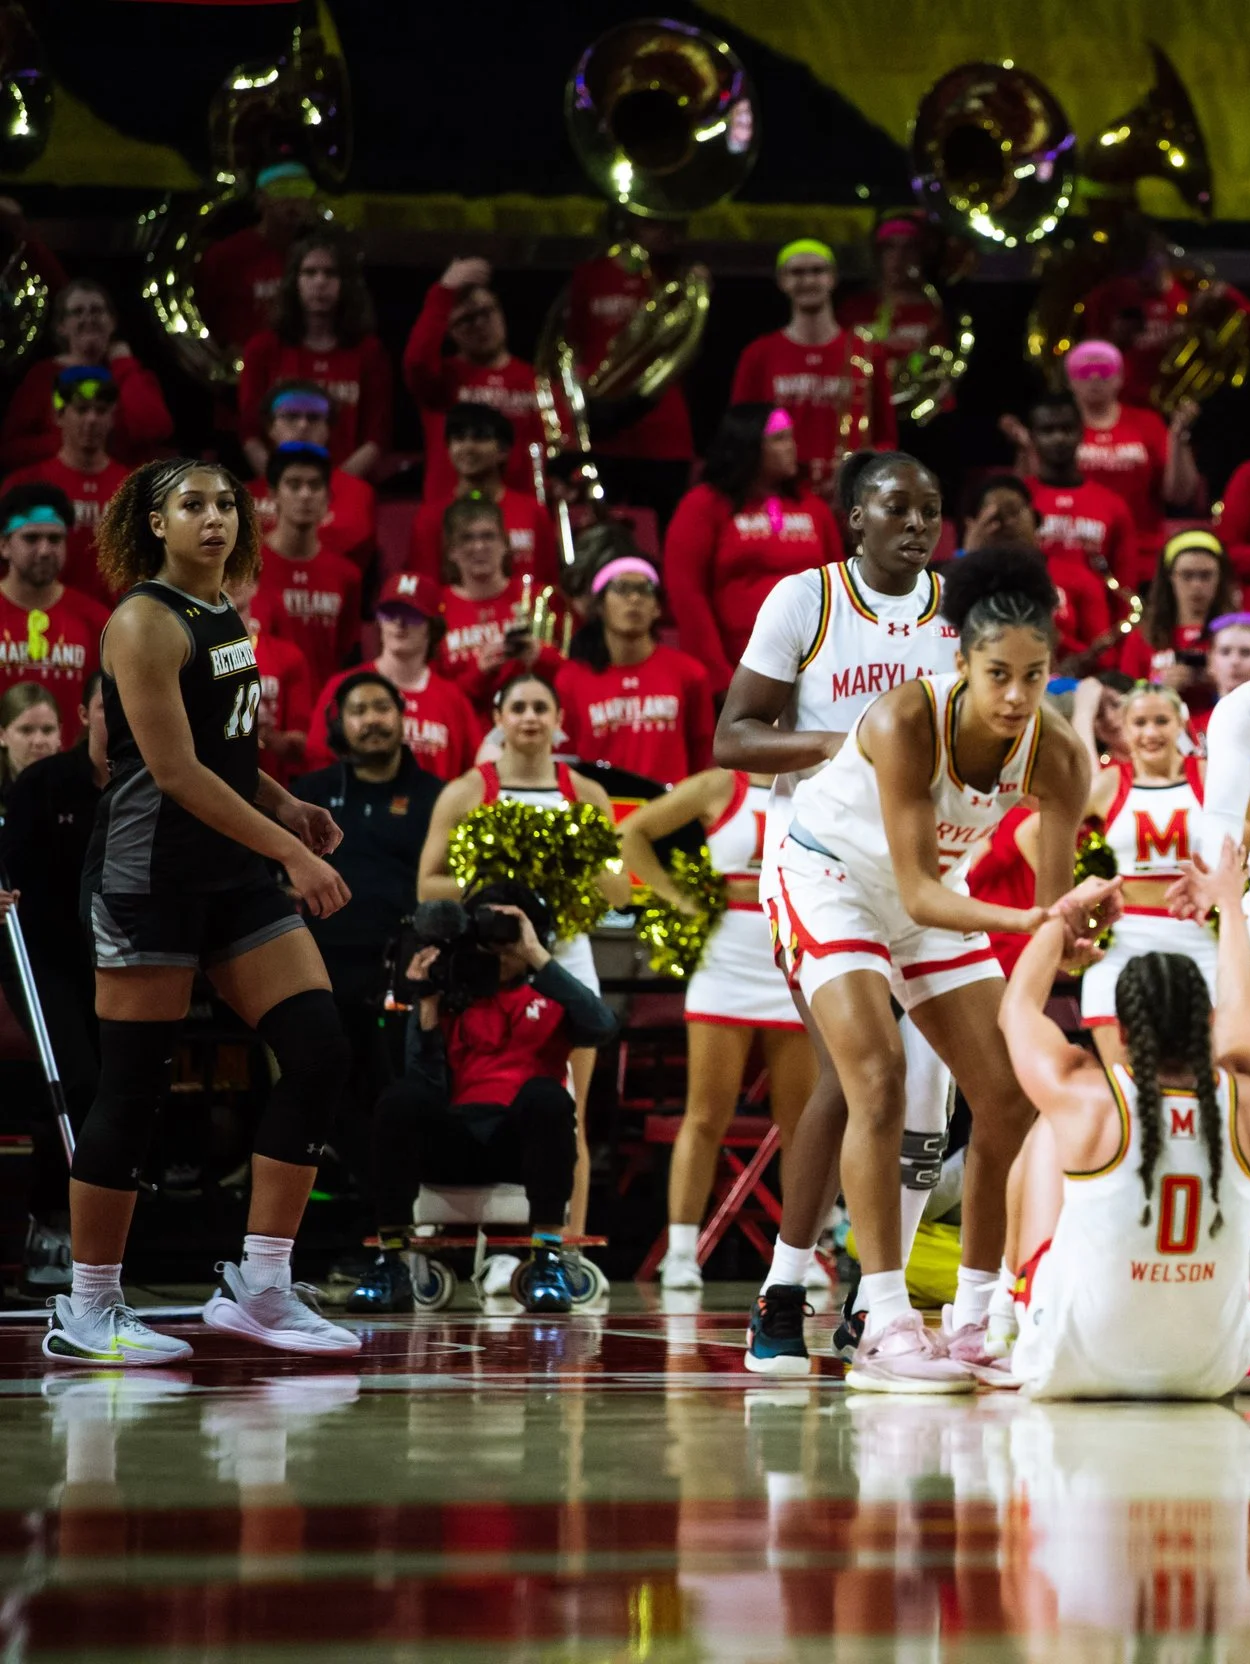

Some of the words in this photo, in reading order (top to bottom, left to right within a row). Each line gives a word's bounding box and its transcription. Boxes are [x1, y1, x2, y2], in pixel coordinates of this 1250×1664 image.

[1132, 808, 1192, 863] M
[1171, 1108, 1194, 1136] M
[1156, 1174, 1202, 1256] 0
[1131, 1261, 1215, 1282] WELSON
